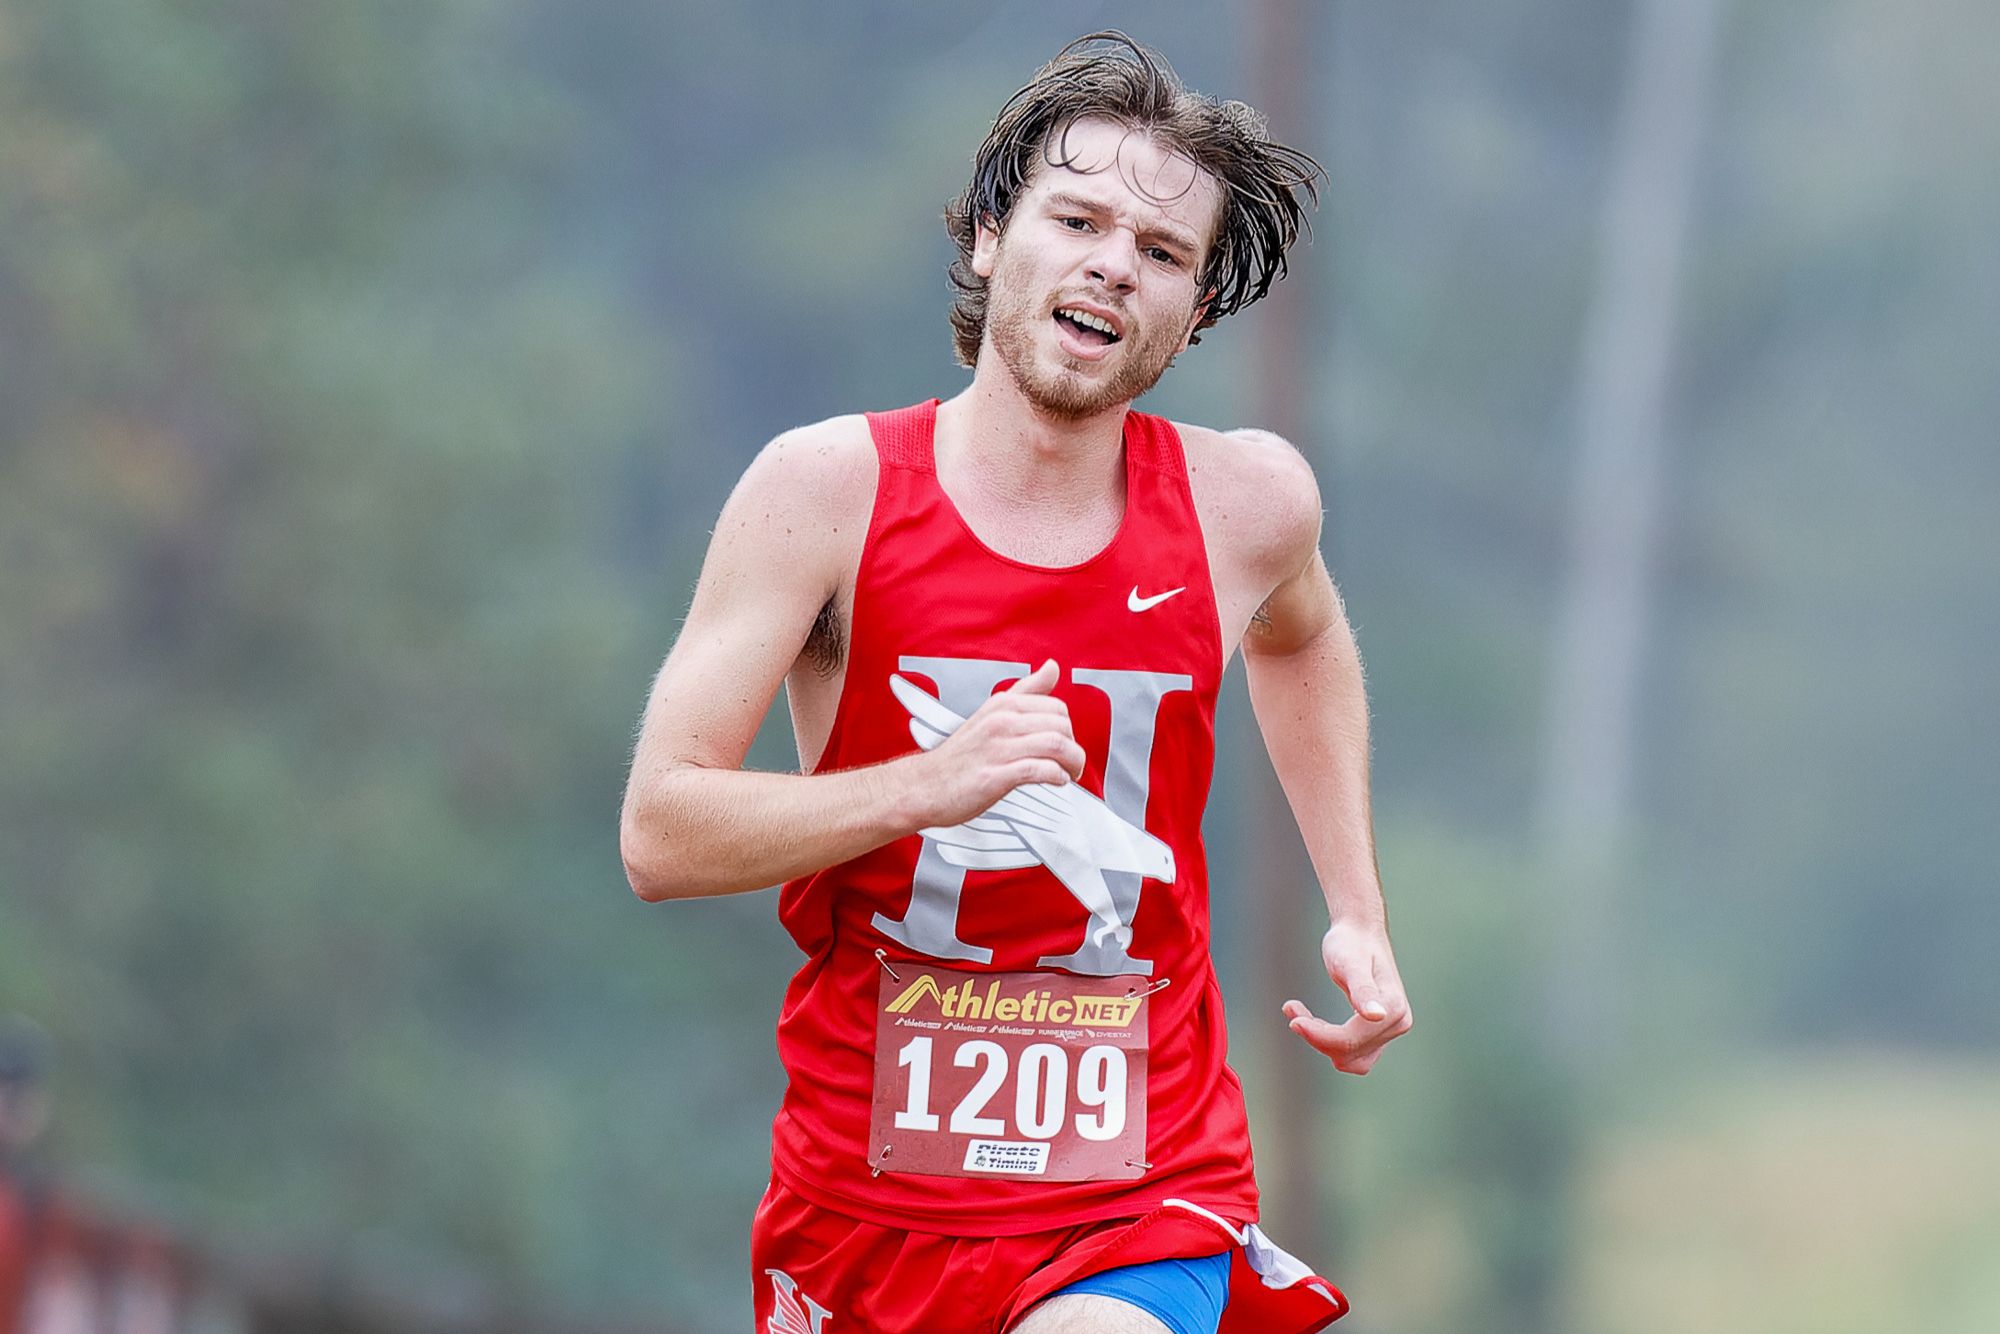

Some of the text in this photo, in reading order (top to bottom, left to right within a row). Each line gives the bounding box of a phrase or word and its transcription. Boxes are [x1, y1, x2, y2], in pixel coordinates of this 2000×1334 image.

[1082, 1003, 1131, 1021] NET
[894, 1036, 1128, 1141] 1209
[977, 1144, 1041, 1156] Pirate
[989, 1157, 1038, 1171] Timing
